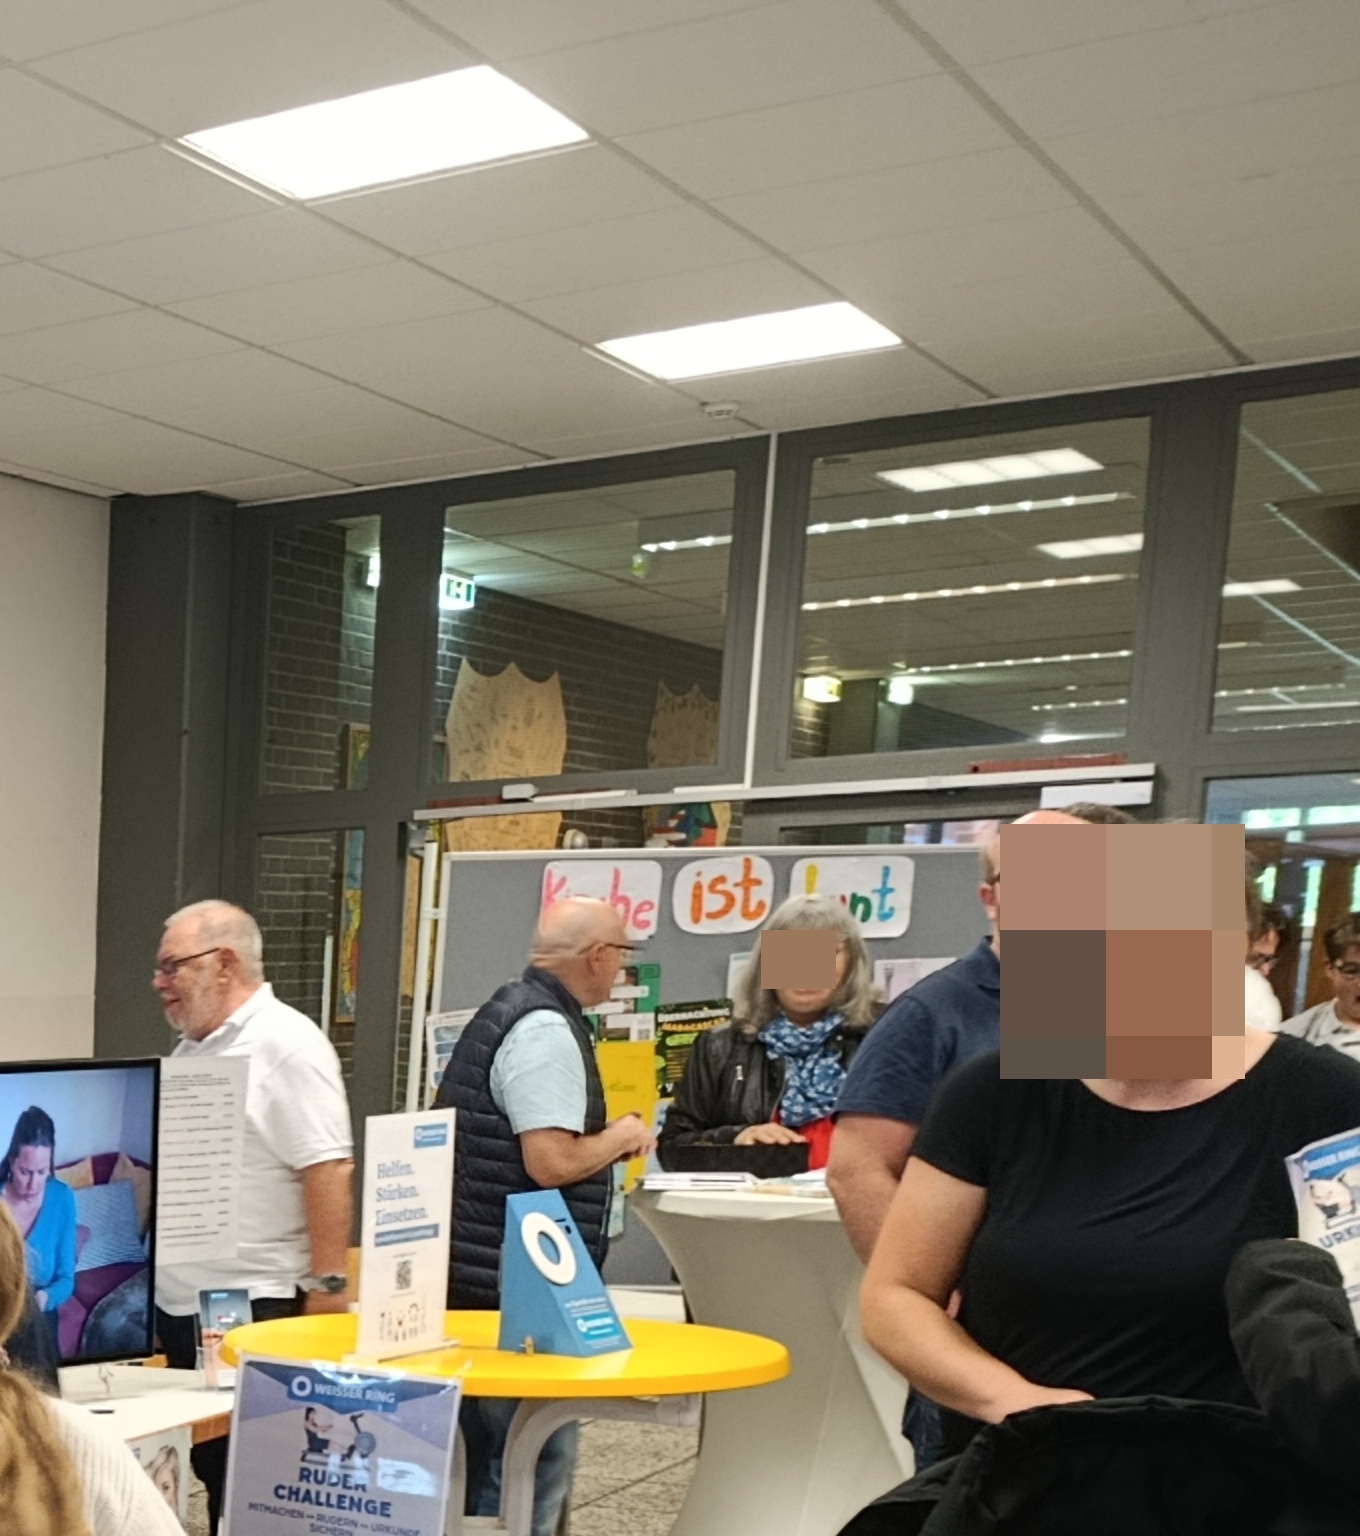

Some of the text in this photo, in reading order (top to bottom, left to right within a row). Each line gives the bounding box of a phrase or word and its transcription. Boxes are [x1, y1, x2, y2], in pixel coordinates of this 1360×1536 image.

[691, 857, 766, 924] ist
[377, 1160, 414, 1179] Helfen.
[376, 1183, 419, 1202] Stärken.
[375, 1207, 428, 1226] Einsetzen.
[314, 1383, 395, 1404] WEISSER RING
[299, 1467, 367, 1493] RUDER
[274, 1485, 392, 1518] CHALLENGE
[248, 1503, 304, 1520] MITMACHEN
[316, 1513, 358, 1529] RUDERN
